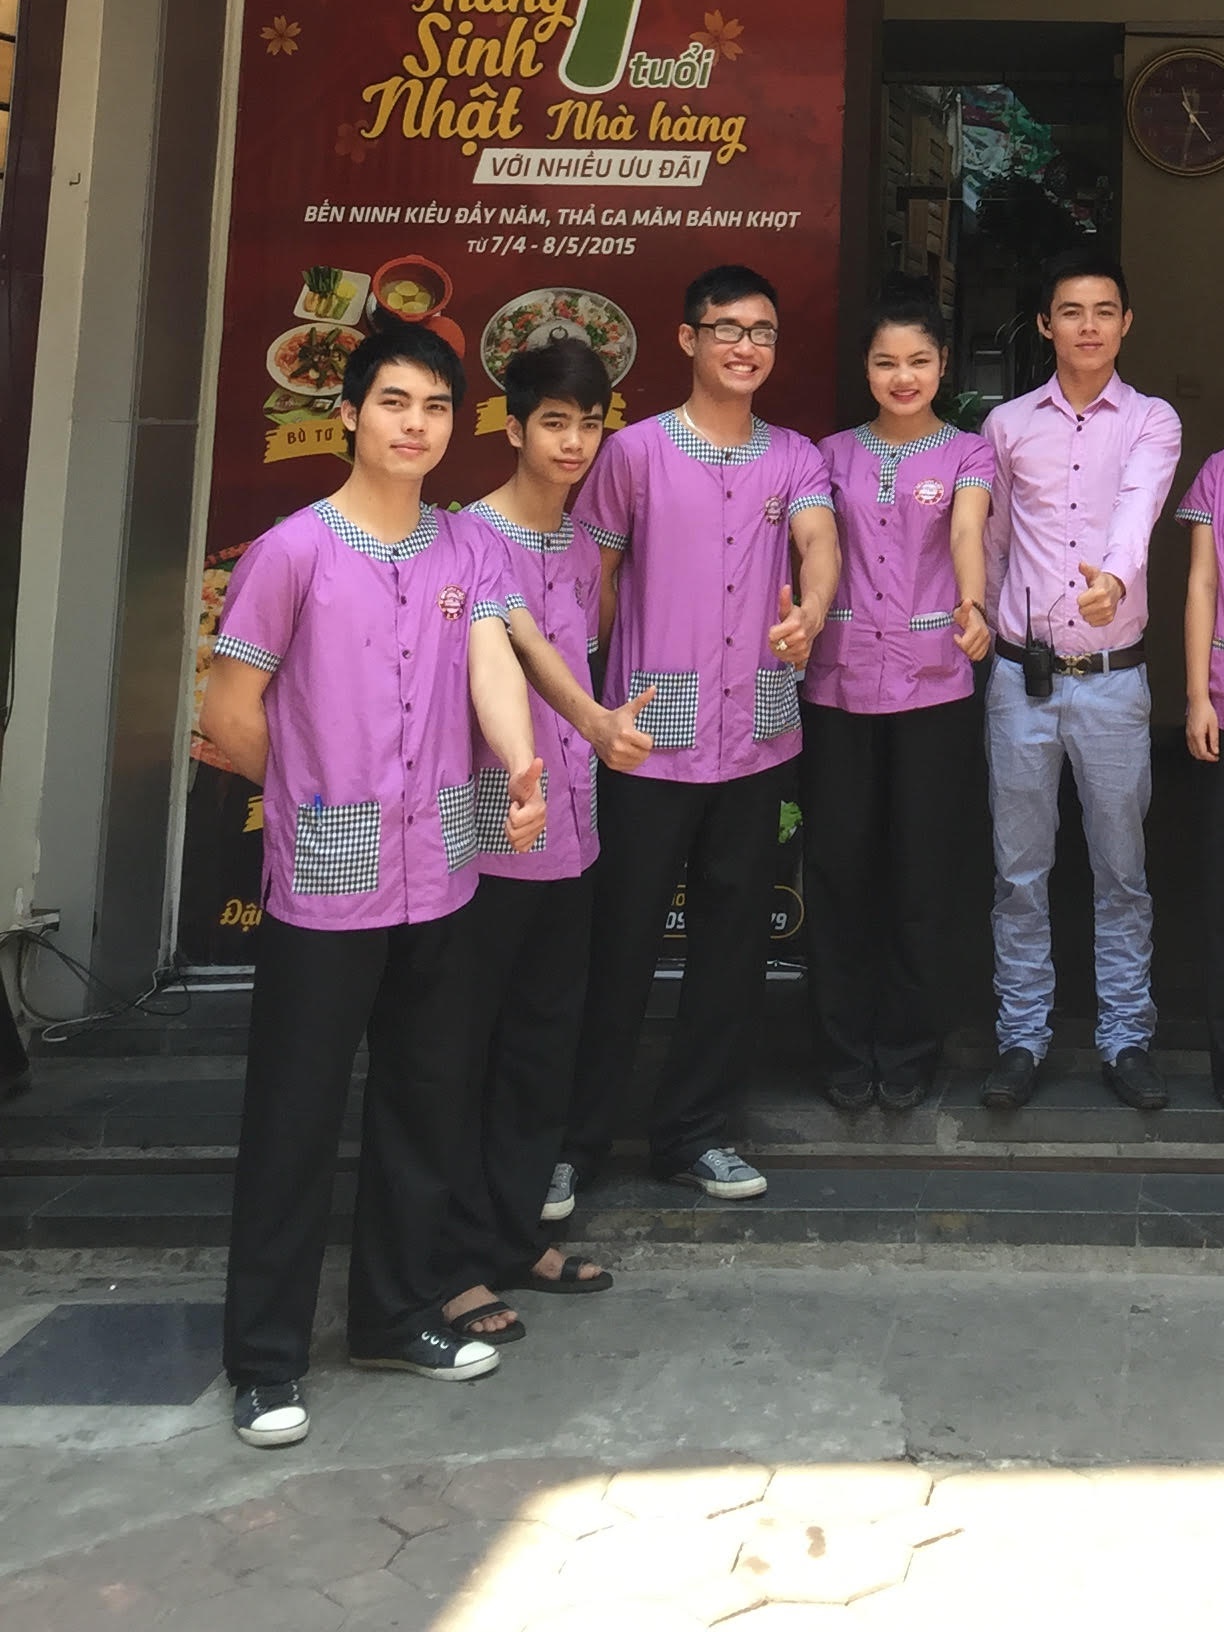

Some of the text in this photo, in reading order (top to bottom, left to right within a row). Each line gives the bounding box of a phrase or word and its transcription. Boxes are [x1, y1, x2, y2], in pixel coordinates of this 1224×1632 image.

[403, 12, 545, 79] Sinh
[629, 42, 716, 89] tuổi
[360, 75, 748, 166] Nhật Nhà hàng
[491, 152, 531, 177] VỚI
[618, 156, 653, 178] ƯU
[658, 155, 702, 179] ĐÃI
[304, 199, 345, 223] BẾN
[348, 206, 401, 223] NINH
[557, 202, 597, 227] THẢ
[600, 208, 628, 227] GA
[686, 206, 743, 229] BÁNH
[746, 211, 802, 233] KHỌT
[490, 235, 527, 257] 7/4
[542, 236, 637, 258] 8/5/2015
[287, 428, 306, 445] BÒ
